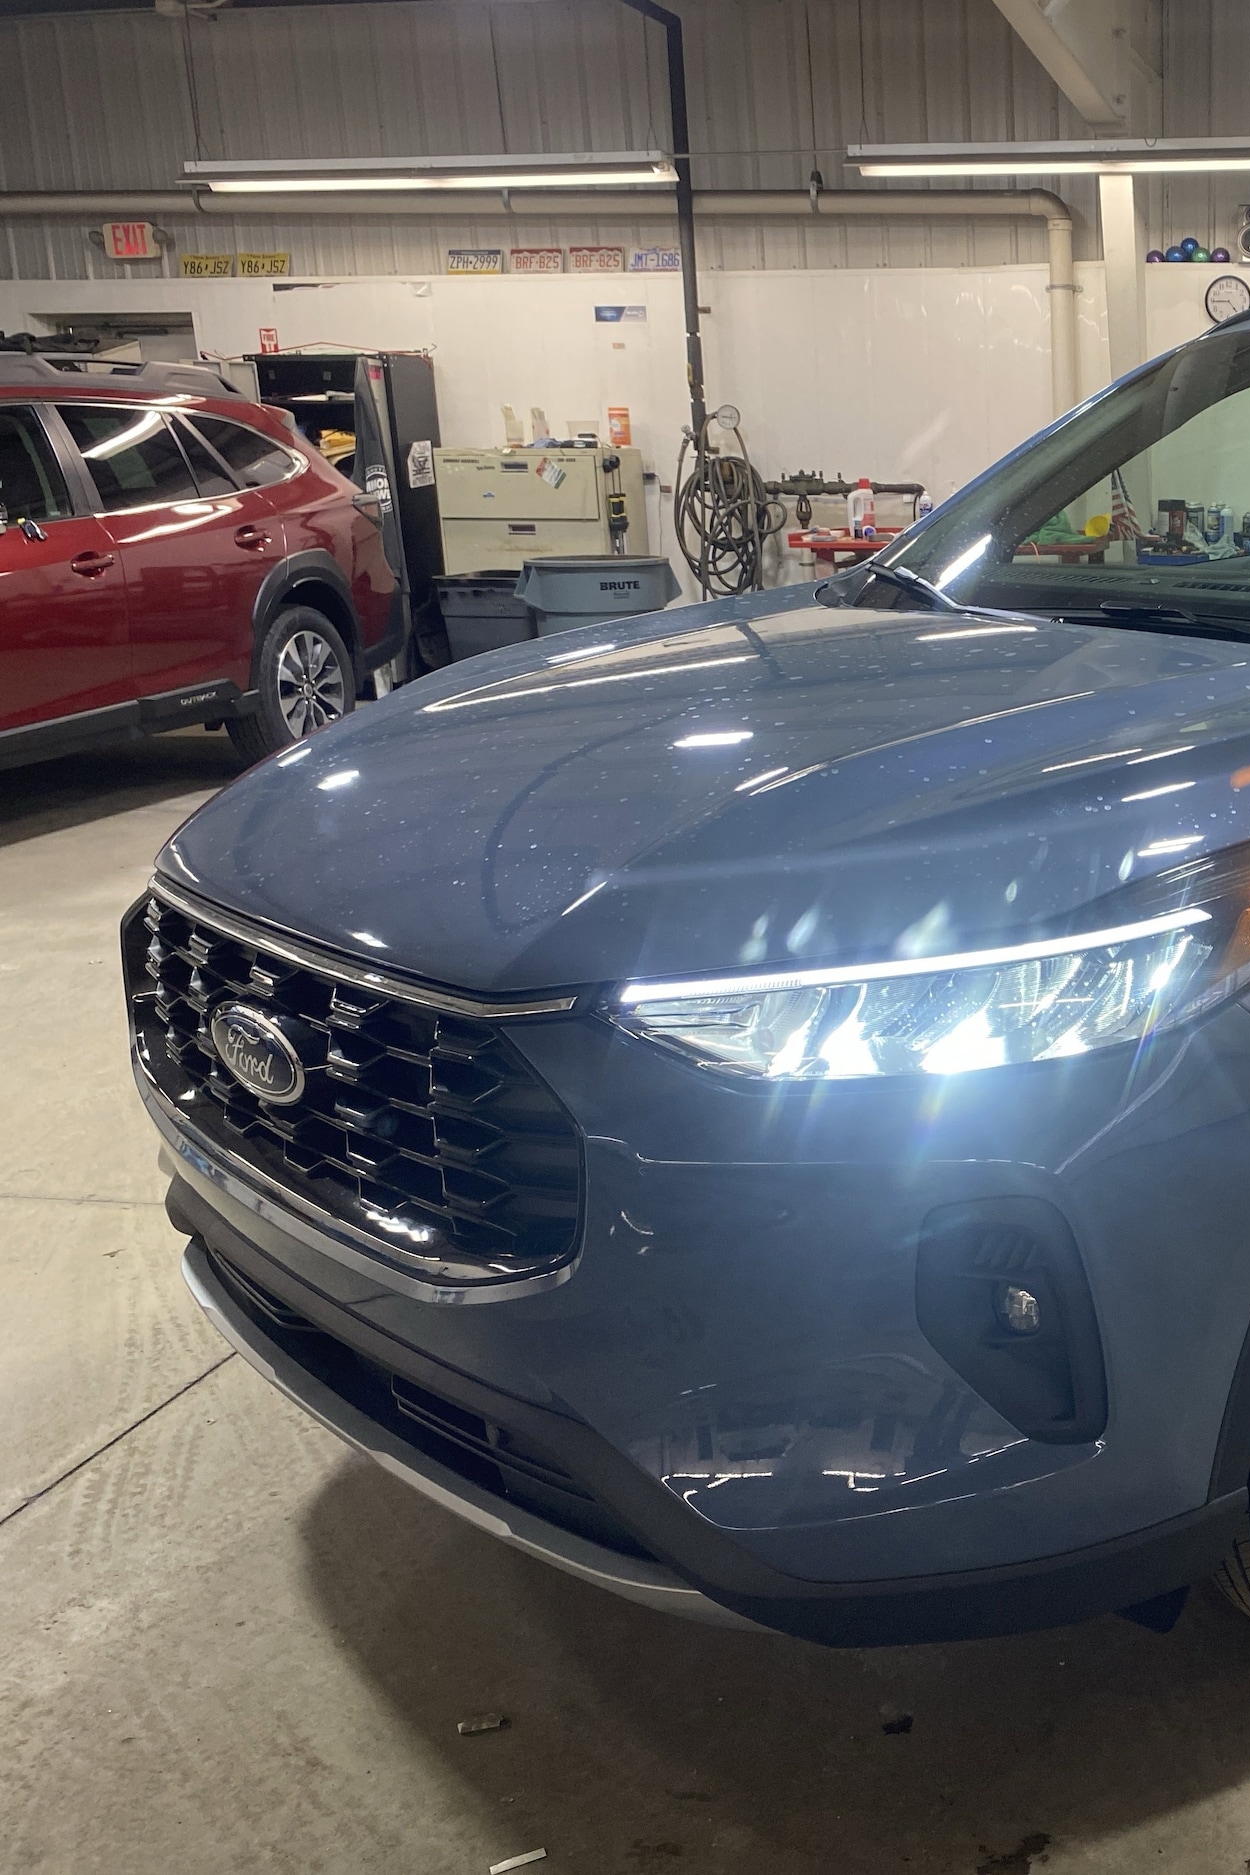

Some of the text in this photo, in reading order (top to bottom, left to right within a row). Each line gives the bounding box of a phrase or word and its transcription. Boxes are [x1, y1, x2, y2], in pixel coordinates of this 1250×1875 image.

[111, 225, 147, 256] EXIT
[599, 580, 641, 591] BRUTE
[225, 1023, 275, 1085] Ford
